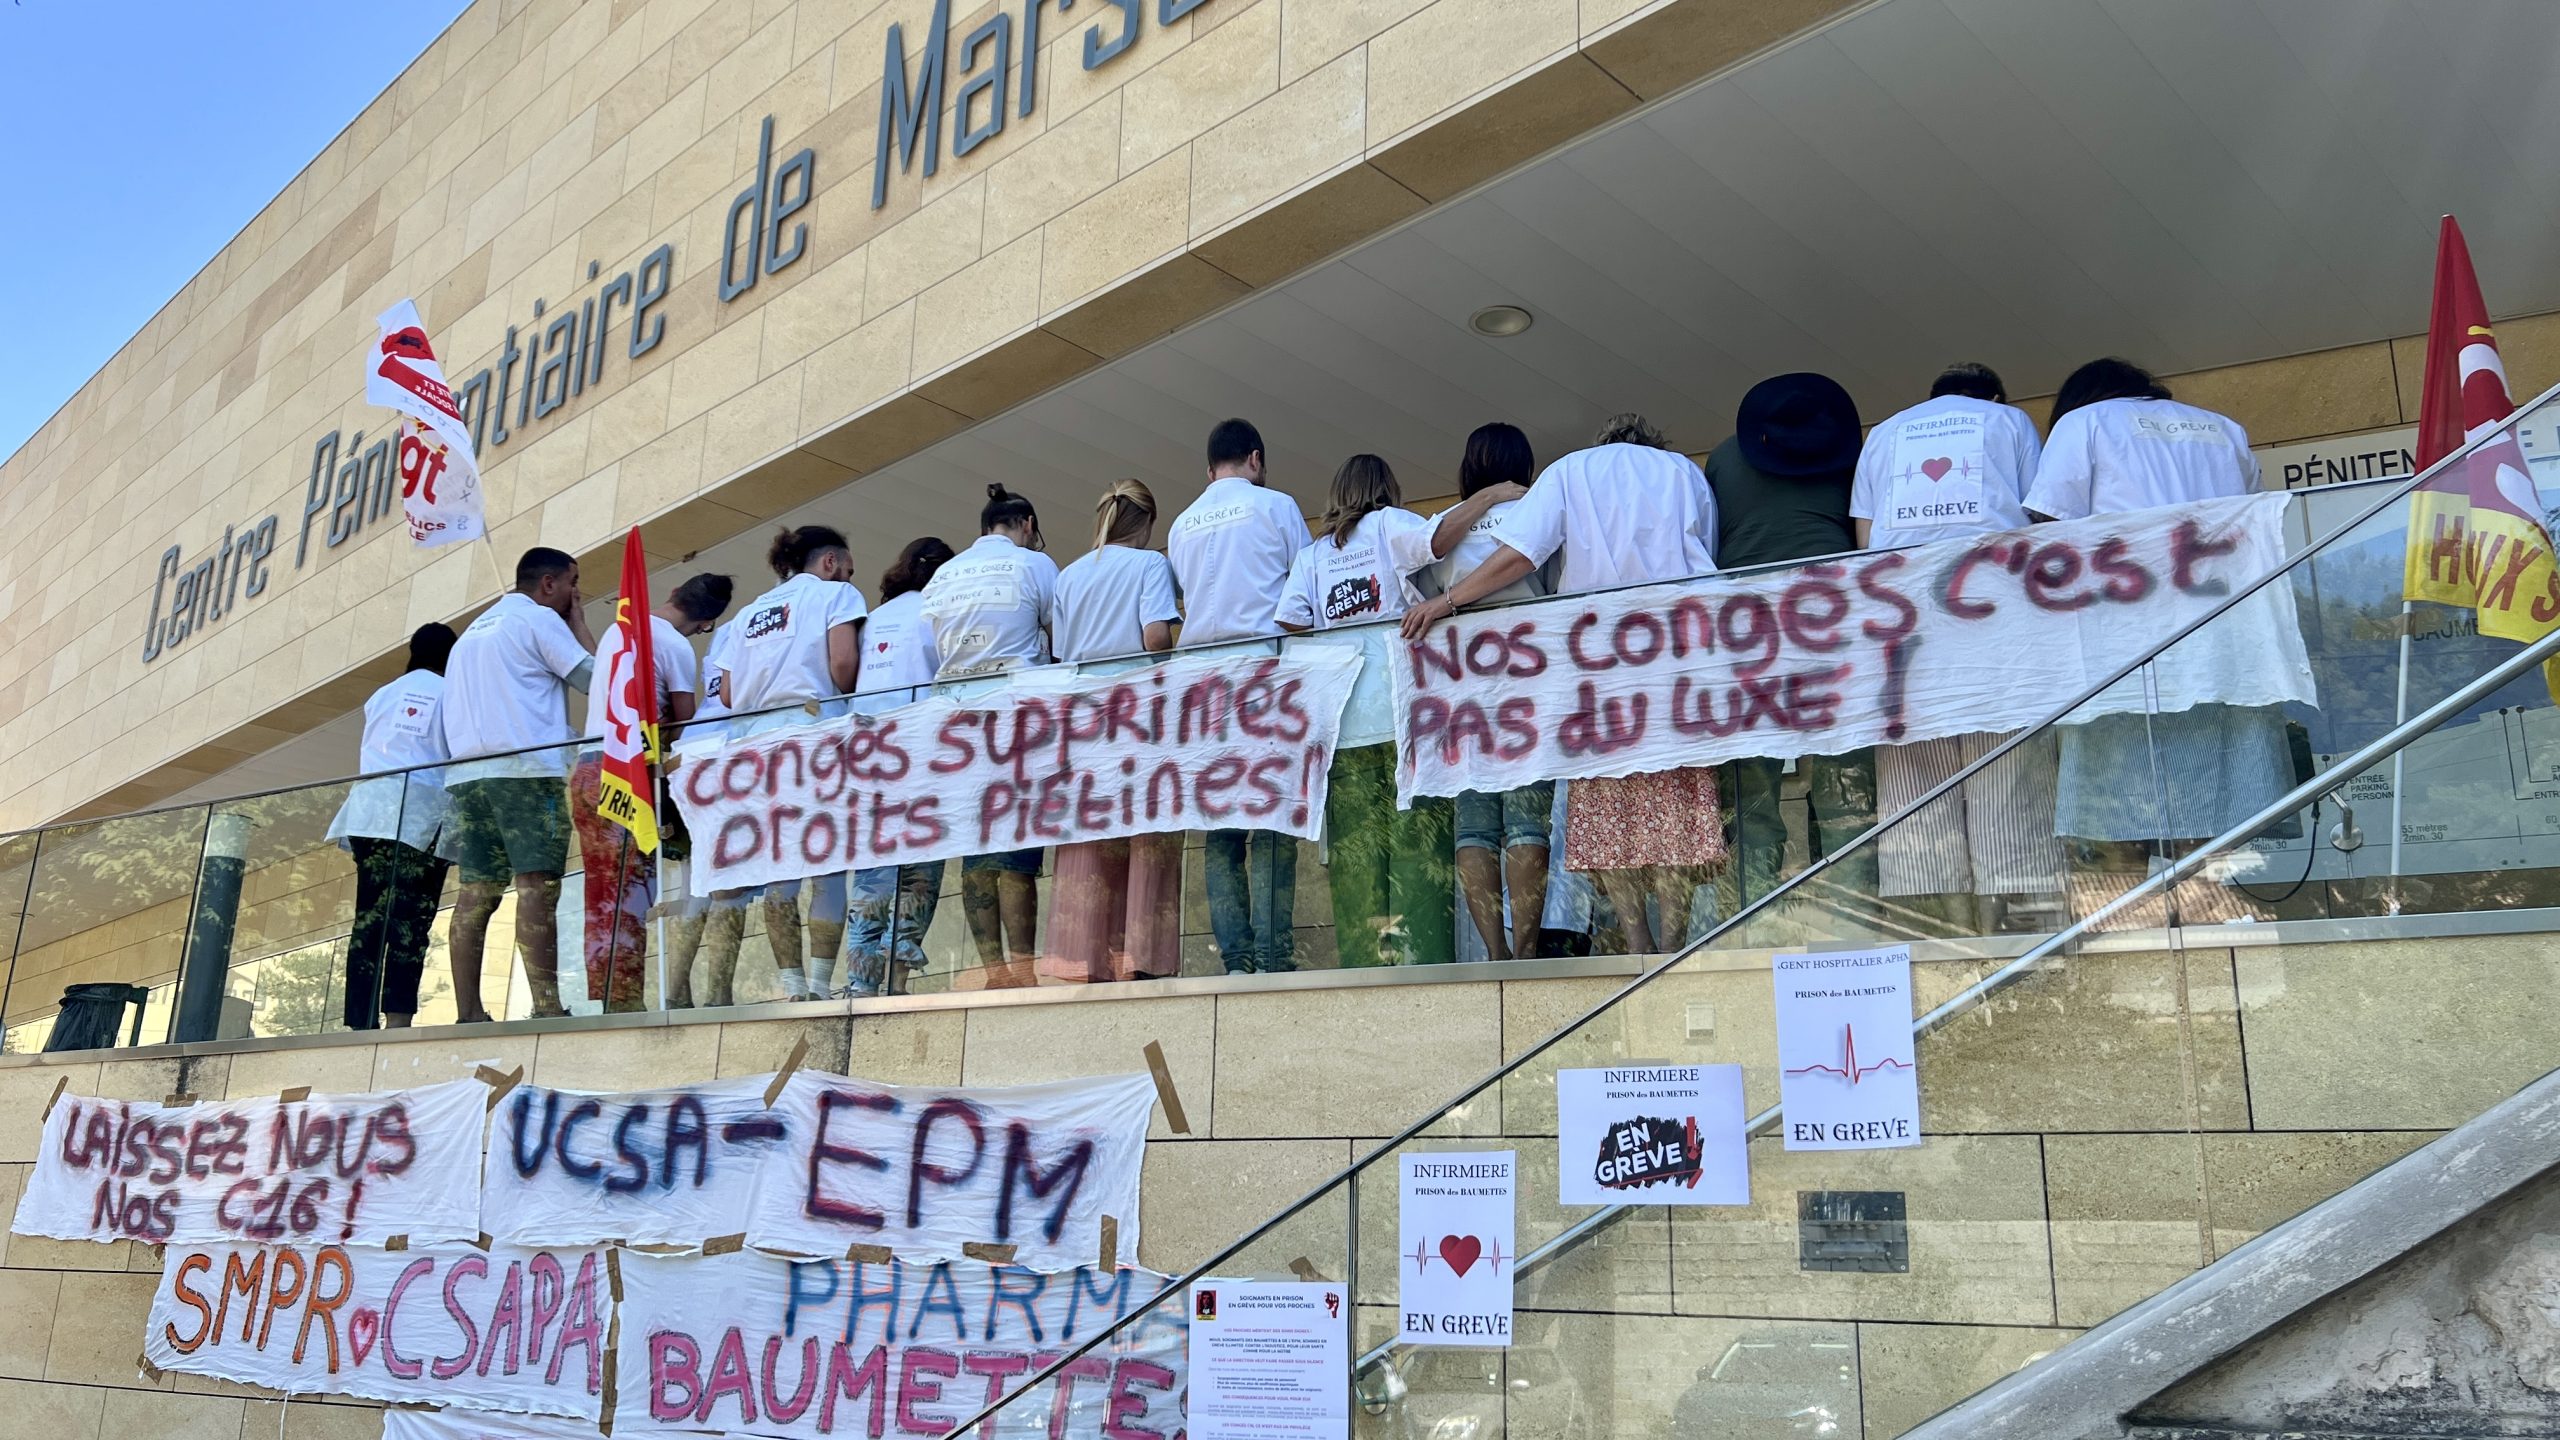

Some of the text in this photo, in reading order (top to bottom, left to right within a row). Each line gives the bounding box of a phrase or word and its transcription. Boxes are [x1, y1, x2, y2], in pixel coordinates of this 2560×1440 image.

[141, 0, 1213, 665] Centre Pénintiaire de Mars
[1906, 417, 1977, 433] INFIRMIERE
[2137, 417, 2161, 433] EN
[400, 435, 449, 506] gt
[2284, 447, 2417, 490] PÉNITEN
[1184, 504, 1244, 532] EN GRÈVE
[1897, 500, 1979, 520] EN GREVE
[1470, 516, 1503, 532] GRÈV
[1328, 547, 1376, 566] INFIRMIERE
[1334, 582, 1354, 600] EN
[1326, 588, 1370, 618] GRÈVE
[756, 609, 771, 622] EN
[2413, 618, 2478, 642] BAUME
[1878, 635, 1922, 741] !
[2349, 774, 2385, 785] ENTRÉE
[2350, 783, 2389, 793] PARKING
[2351, 791, 2396, 801] PERSONN
[2534, 790, 2560, 800] ENTR
[2416, 823, 2449, 832] mètres
[2431, 832, 2443, 841] 30
[2275, 841, 2287, 849] 30
[1777, 960, 1811, 970] GENT
[1813, 956, 1882, 969] HOSPITALIER
[1795, 985, 1897, 999] PRISON des BAUMETTES
[1604, 1068, 1700, 1084] INFIRMIERE
[1606, 1090, 1635, 1099] PRISON
[1649, 1089, 1699, 1099] BAUMETTES
[1616, 1122, 1651, 1151] EN
[1794, 1117, 1910, 1143] EN GREVE
[1597, 1140, 1683, 1182] GRÈVE
[1413, 1164, 1509, 1179] INFIRMIERE
[1415, 1187, 1507, 1196] PRISON des BAUMETTES
[165, 1247, 603, 1396] SMPR CSAPA
[1405, 1312, 1509, 1337] EN GREVE
[648, 1325, 1189, 1440] BAUMETTE
